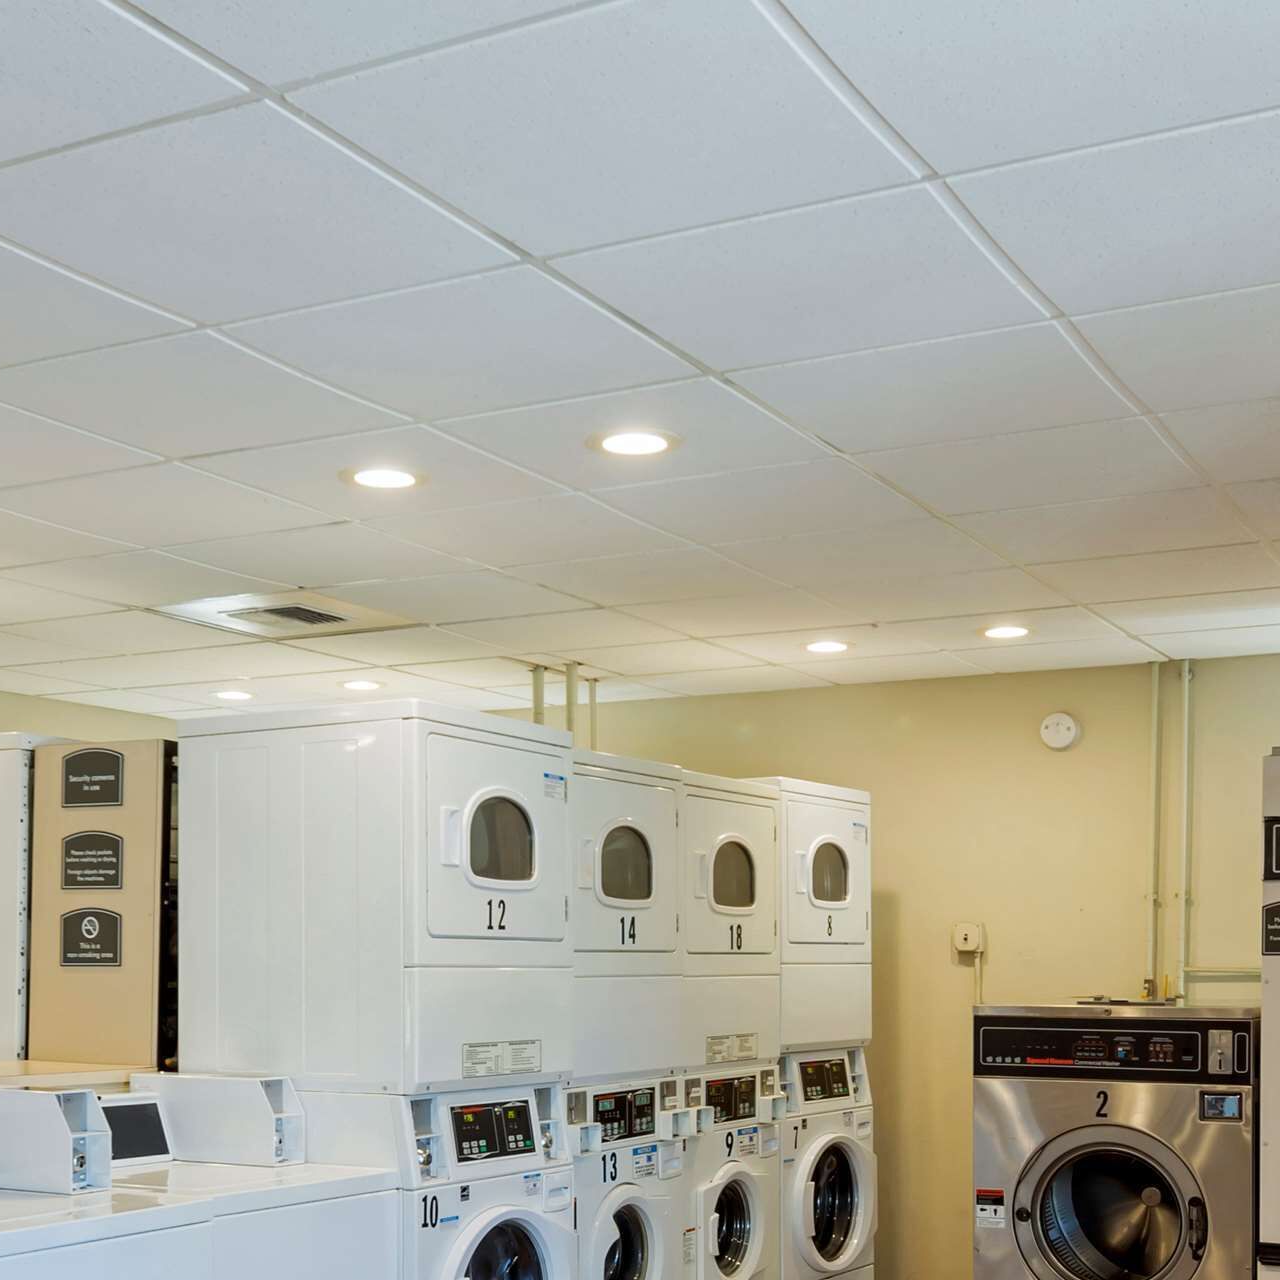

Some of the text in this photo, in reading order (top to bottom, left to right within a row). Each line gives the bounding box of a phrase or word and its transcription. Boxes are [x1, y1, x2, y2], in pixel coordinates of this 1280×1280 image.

[486, 899, 507, 931] 12
[826, 914, 833, 937] 8
[620, 916, 636, 945] 14
[729, 924, 743, 951] 18
[1095, 1090, 1109, 1118] 2
[725, 1131, 734, 1157] 9
[793, 1126, 799, 1150] 7
[601, 1151, 617, 1183] 13
[421, 1194, 439, 1228] 10
